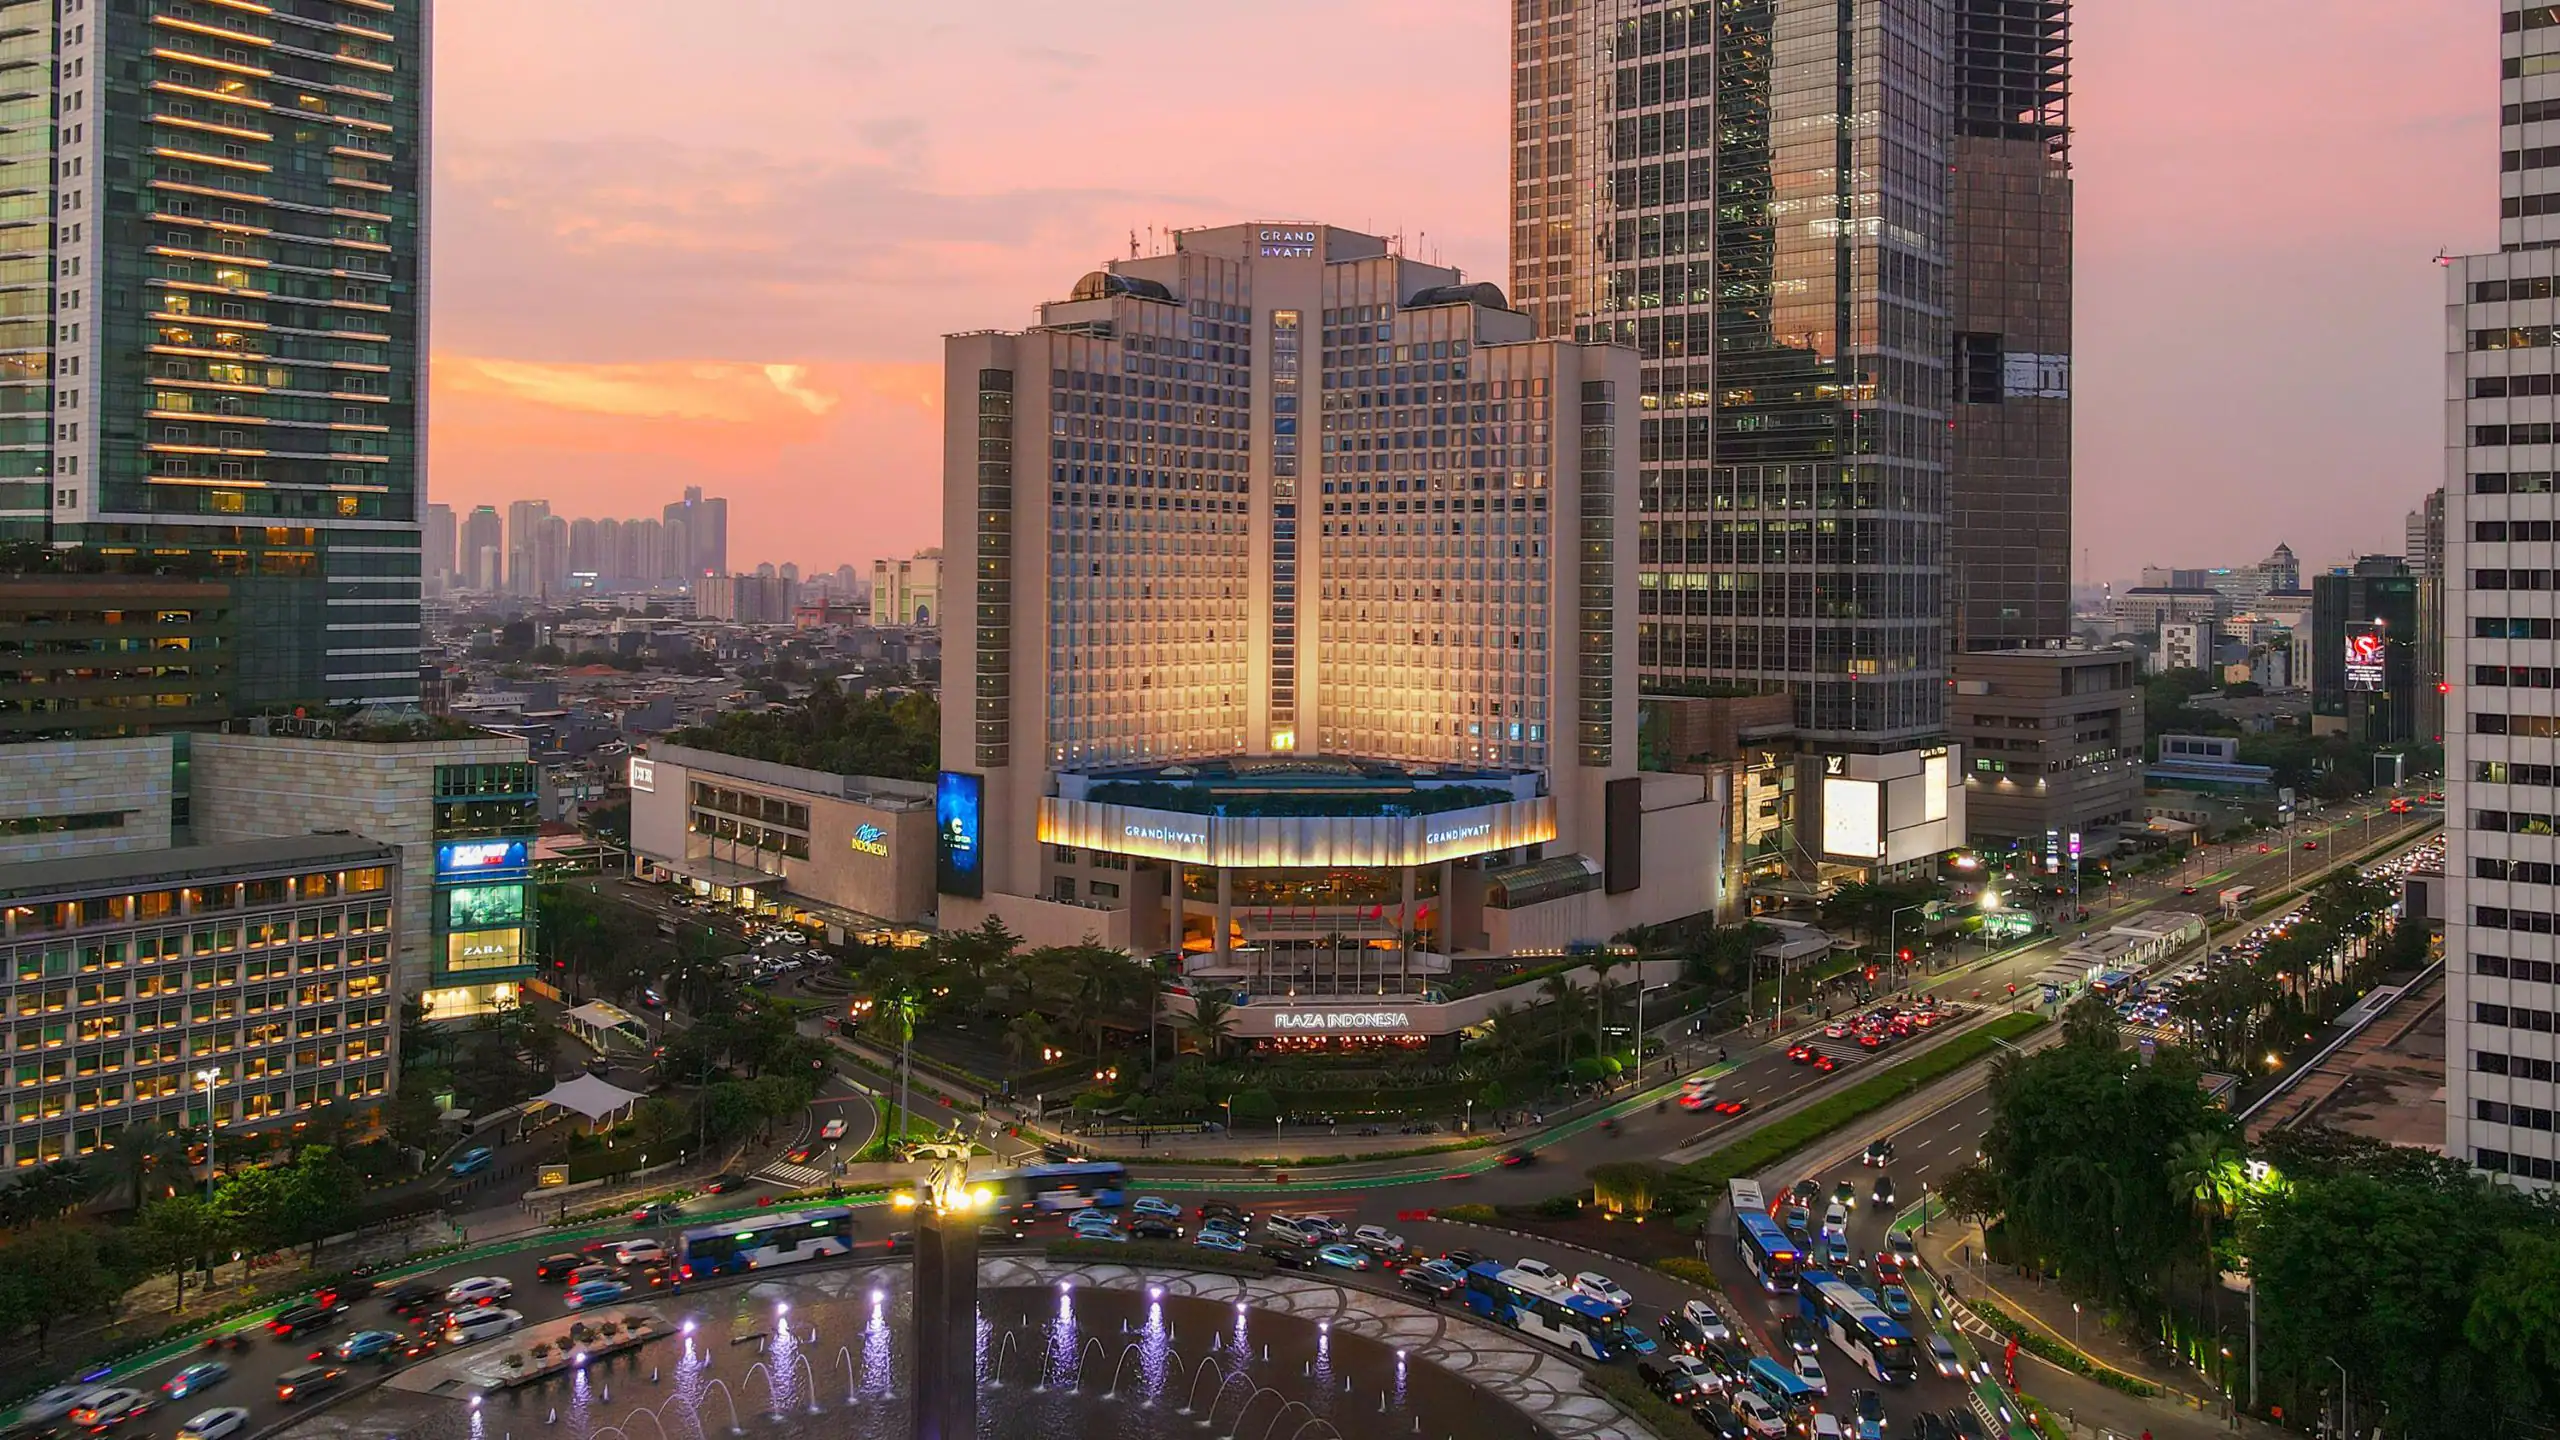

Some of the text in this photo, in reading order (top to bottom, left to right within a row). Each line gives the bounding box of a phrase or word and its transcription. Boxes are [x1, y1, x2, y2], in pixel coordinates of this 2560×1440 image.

[1260, 231, 1315, 242] GRAND
[1261, 247, 1313, 258] HYATT
[635, 766, 652, 783] DIOR
[1125, 826, 1205, 845] GRAND HYATT
[1427, 824, 1490, 844] GRAND HYATT
[852, 838, 888, 857] INDONESIA
[464, 945, 504, 956] ZARA
[1275, 1013, 1409, 1028] PLAZA INDONESIA
